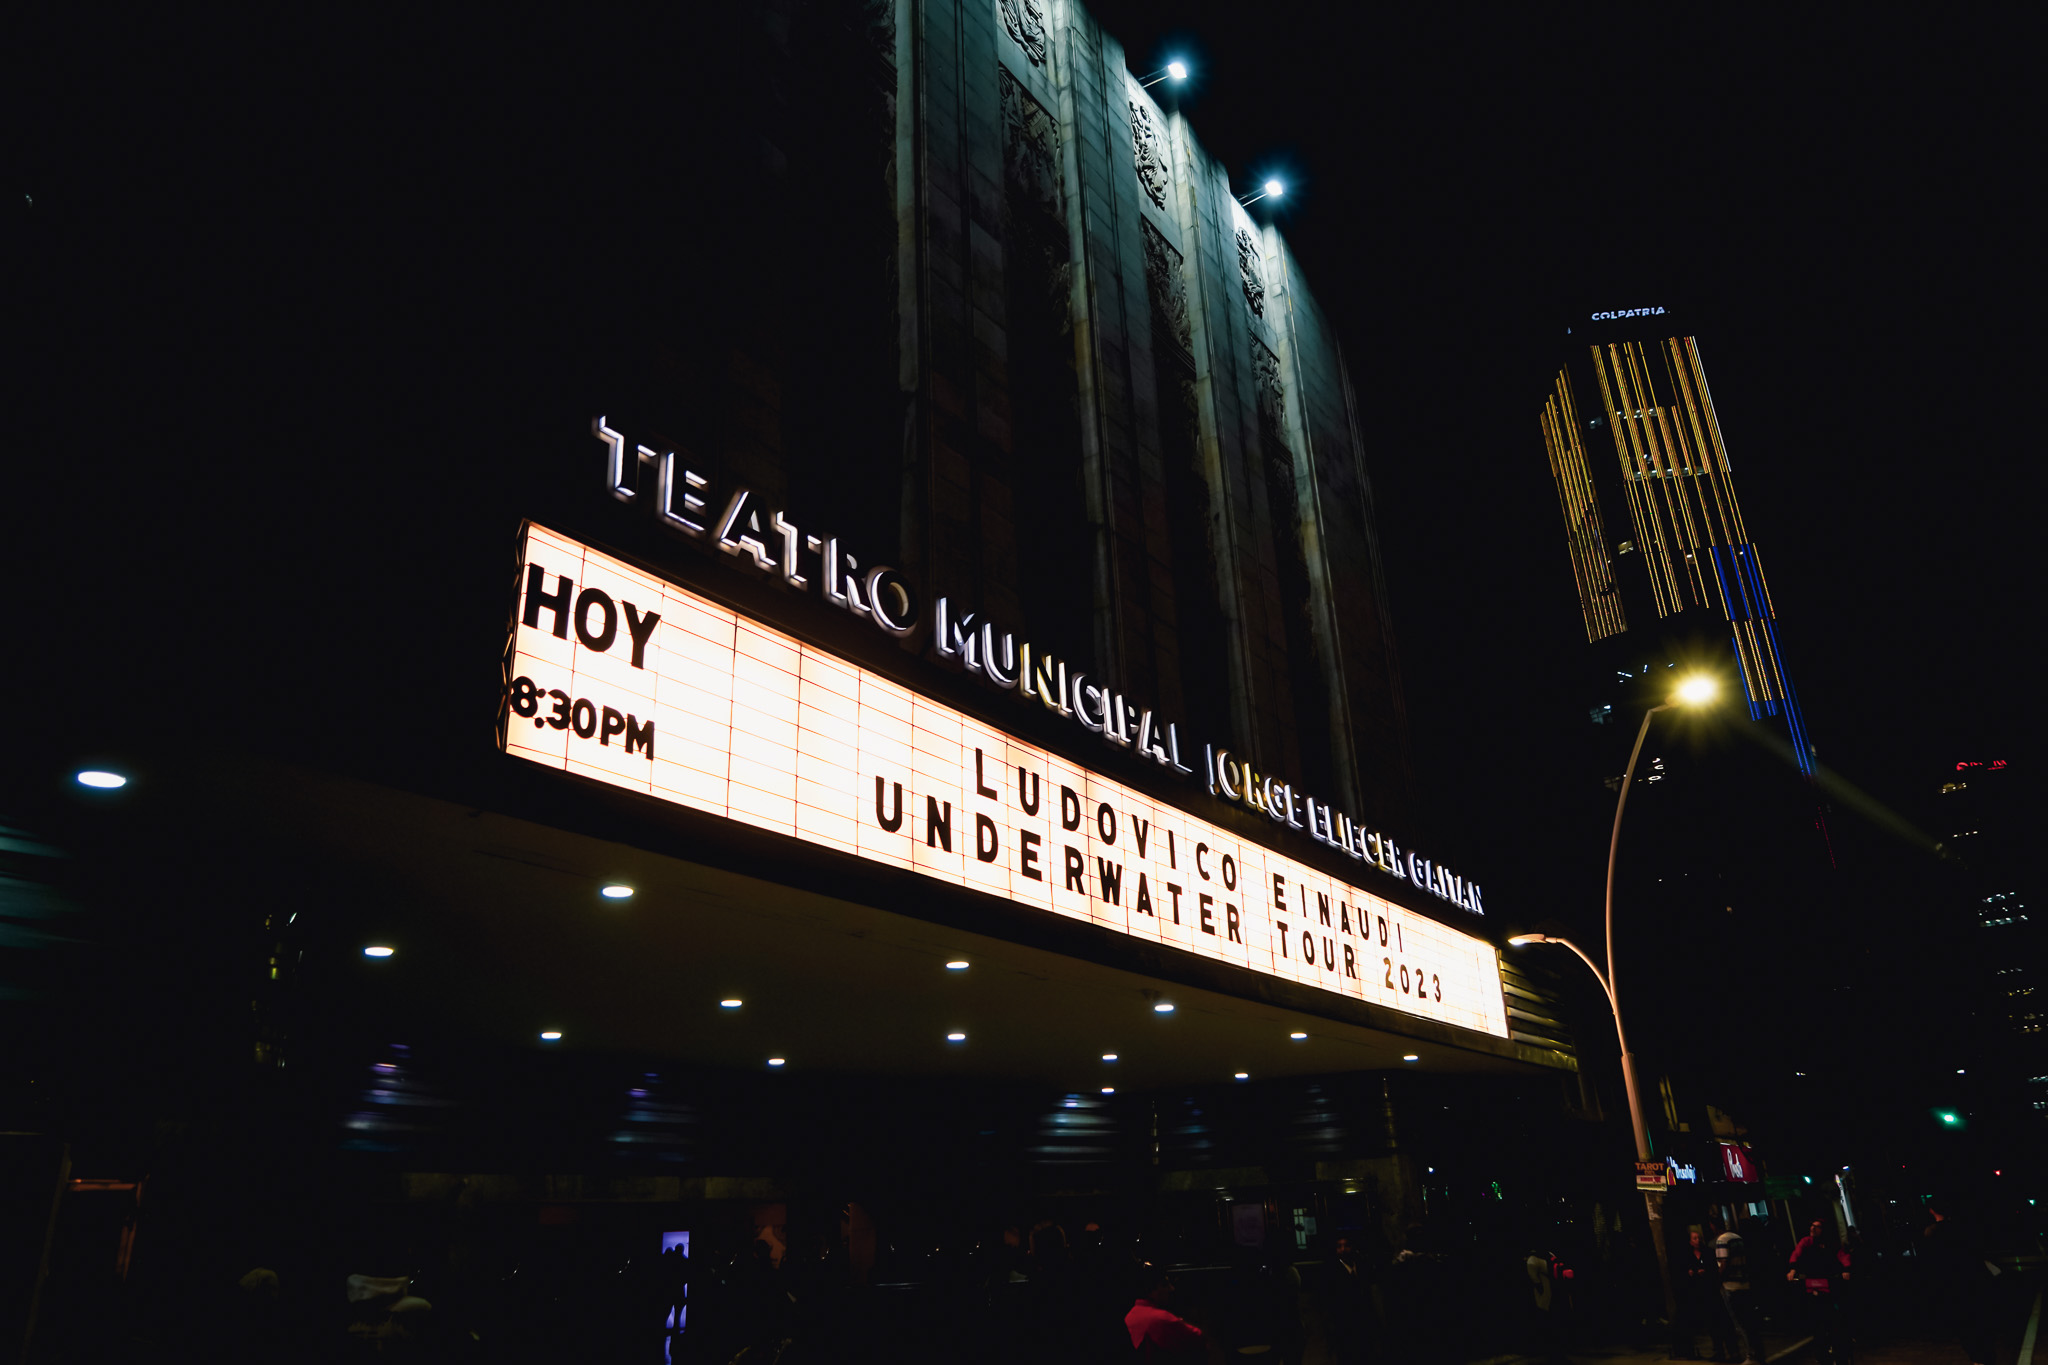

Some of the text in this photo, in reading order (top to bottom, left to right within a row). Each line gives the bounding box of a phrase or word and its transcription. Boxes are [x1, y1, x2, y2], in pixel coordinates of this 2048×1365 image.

[1592, 306, 1665, 320] COLPATRIA
[522, 562, 662, 670] HOY
[593, 415, 919, 637] TEATRO
[934, 597, 1193, 775] MUNICIPAL
[1204, 743, 1304, 829] JORGE
[1306, 797, 1407, 879] ELIECER
[875, 776, 1442, 1003] UNDERWATER TOUR 2023
[975, 747, 1403, 953] LUDOVICO EINAUDI
[1635, 1162, 1664, 1171] TAROT
